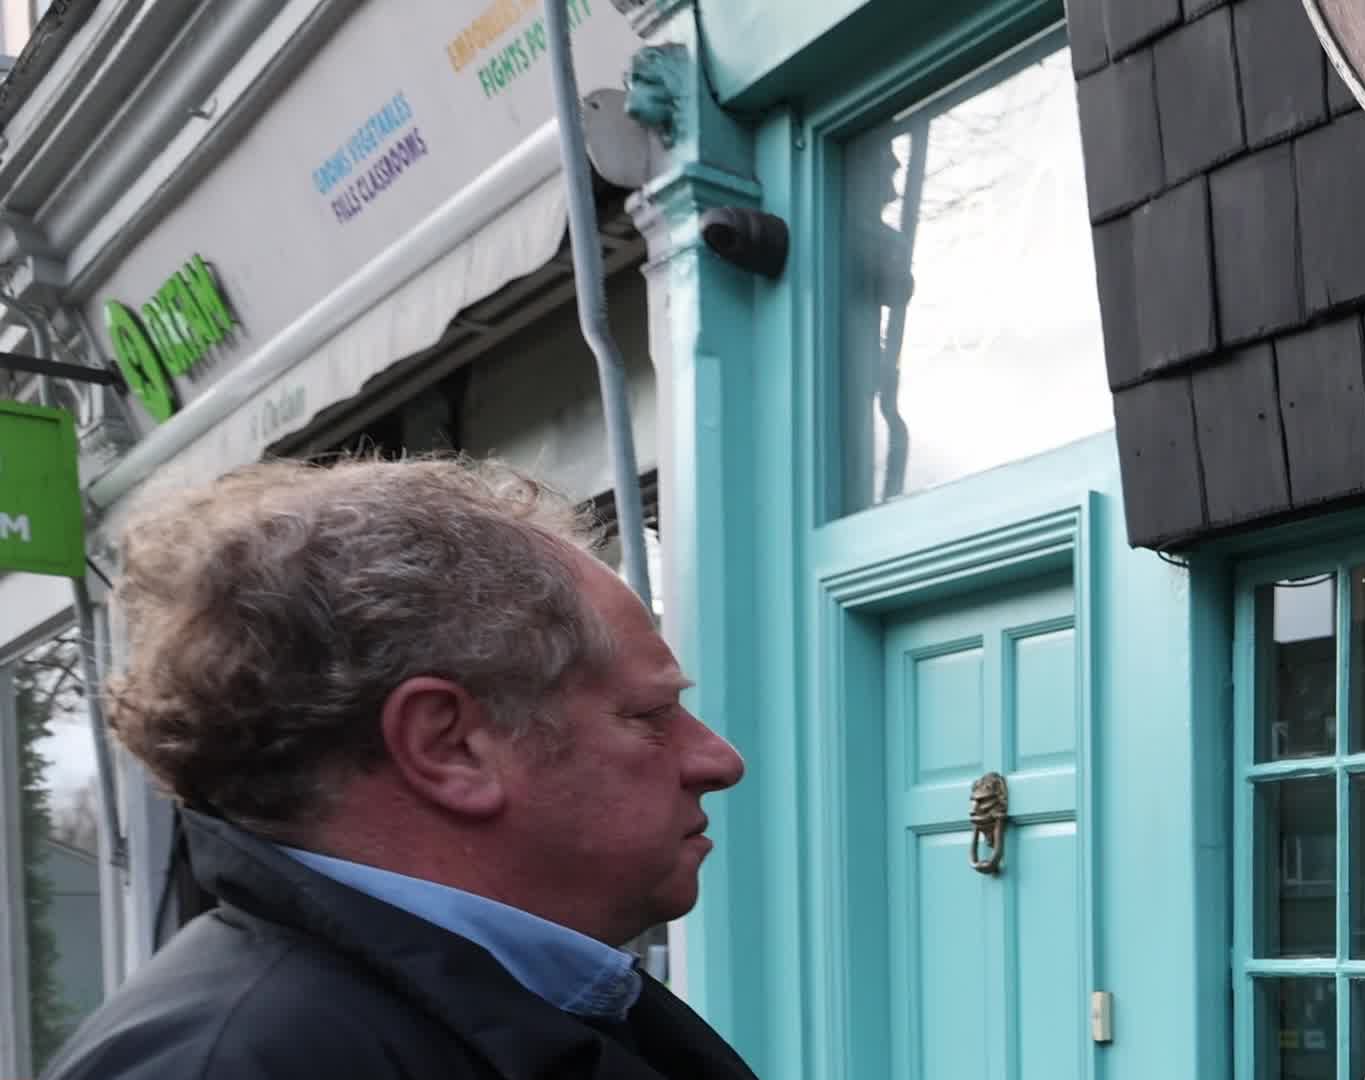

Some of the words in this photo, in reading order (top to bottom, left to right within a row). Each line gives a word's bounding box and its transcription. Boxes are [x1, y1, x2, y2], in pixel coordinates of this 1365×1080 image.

[478, 37, 530, 98] FIGHTS
[356, 127, 428, 203] CLASSROOMS
[141, 252, 234, 376] OXFAM
